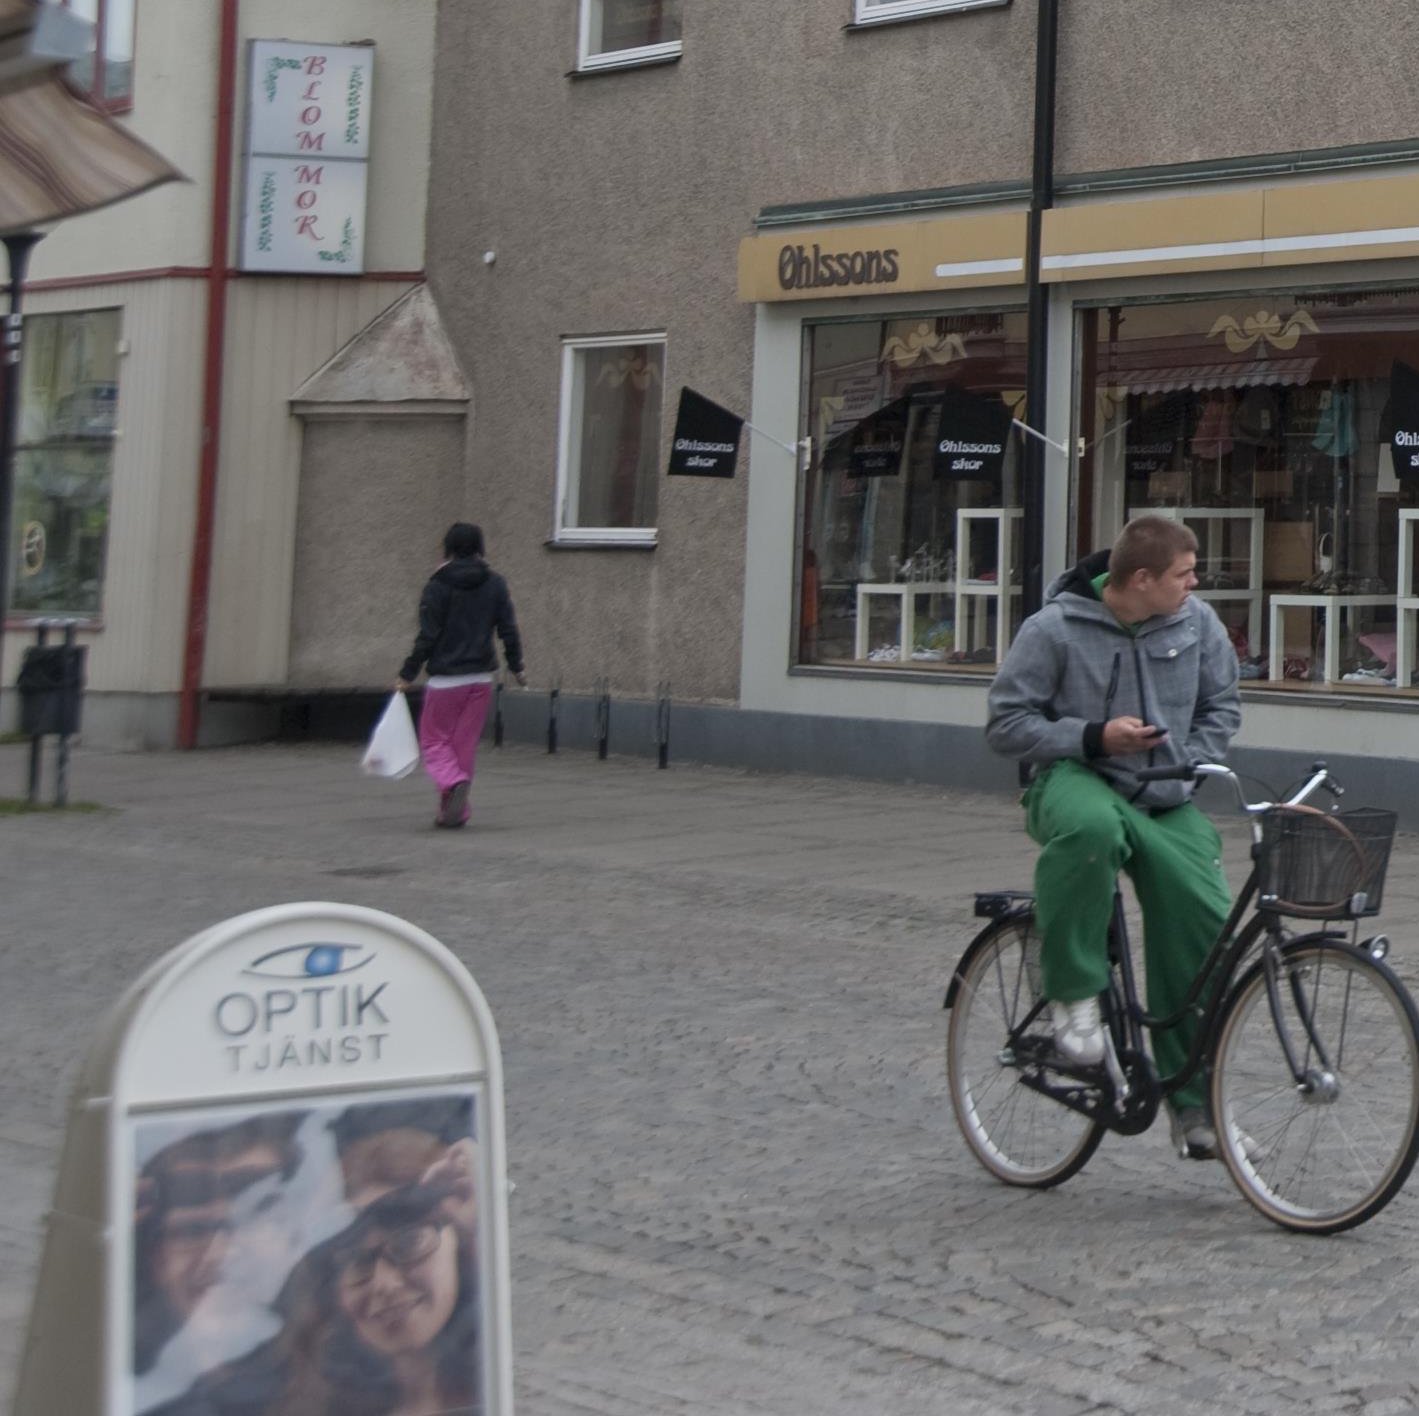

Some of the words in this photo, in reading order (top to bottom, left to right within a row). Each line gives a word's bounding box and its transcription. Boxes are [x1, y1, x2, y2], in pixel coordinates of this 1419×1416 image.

[294, 55, 327, 241] BLOMMOR
[686, 455, 718, 468] skor
[952, 458, 983, 471] skor
[215, 982, 391, 1037] OPTIK
[227, 1033, 391, 1073] TJÄNST
